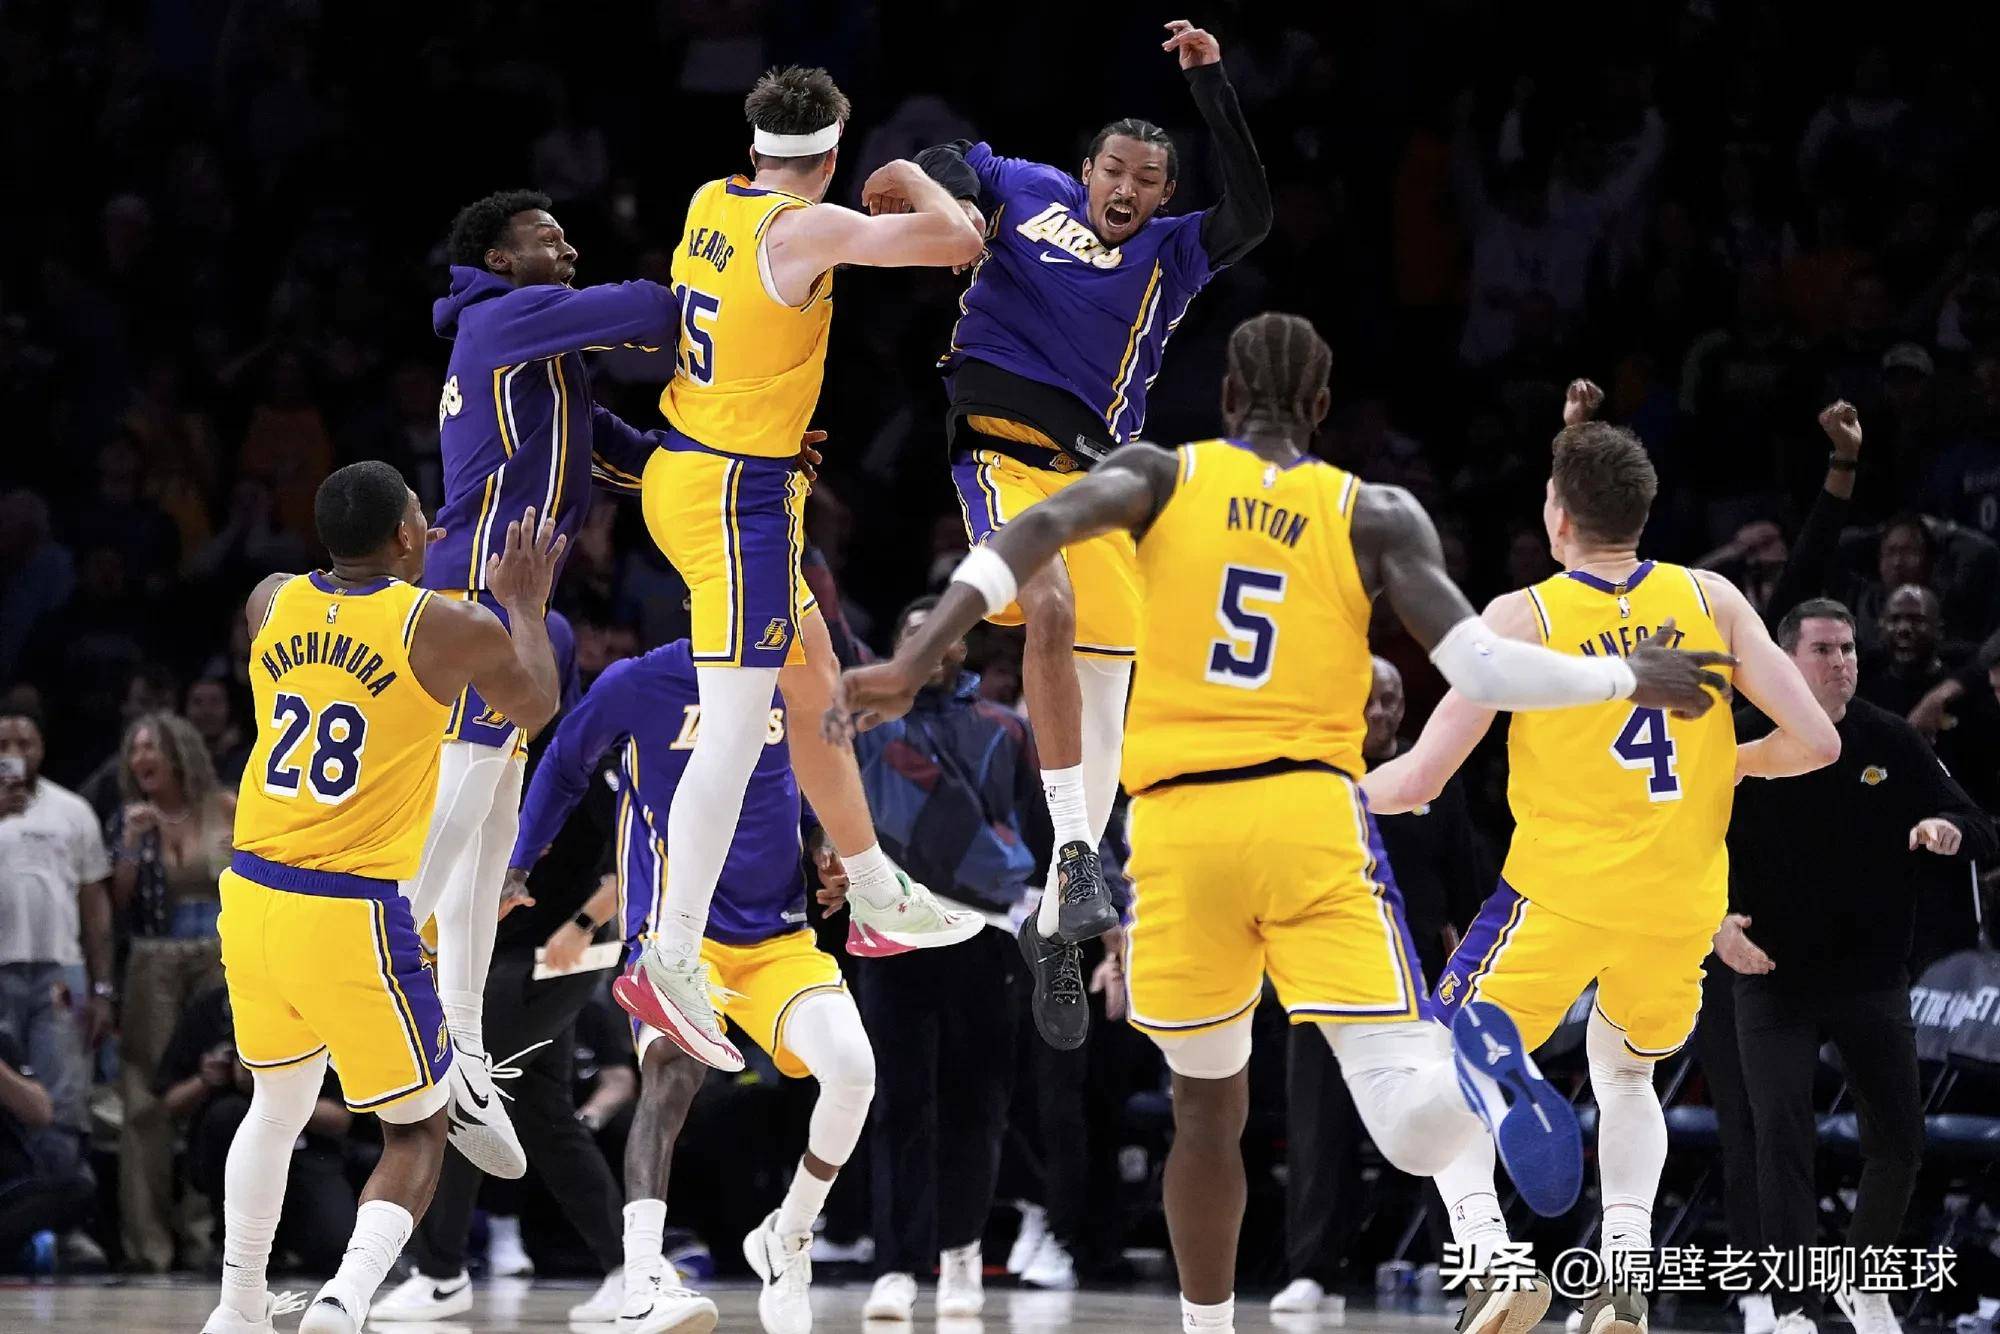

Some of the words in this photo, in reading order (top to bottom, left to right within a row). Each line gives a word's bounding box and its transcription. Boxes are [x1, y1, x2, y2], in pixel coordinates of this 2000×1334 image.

[1227, 496, 1310, 549] AYTON
[261, 631, 398, 698] HACHIMURA
[1204, 561, 1288, 691] 5
[1579, 625, 1686, 659] KNECT
[264, 692, 369, 806] 28
[1608, 703, 1684, 803] 4
